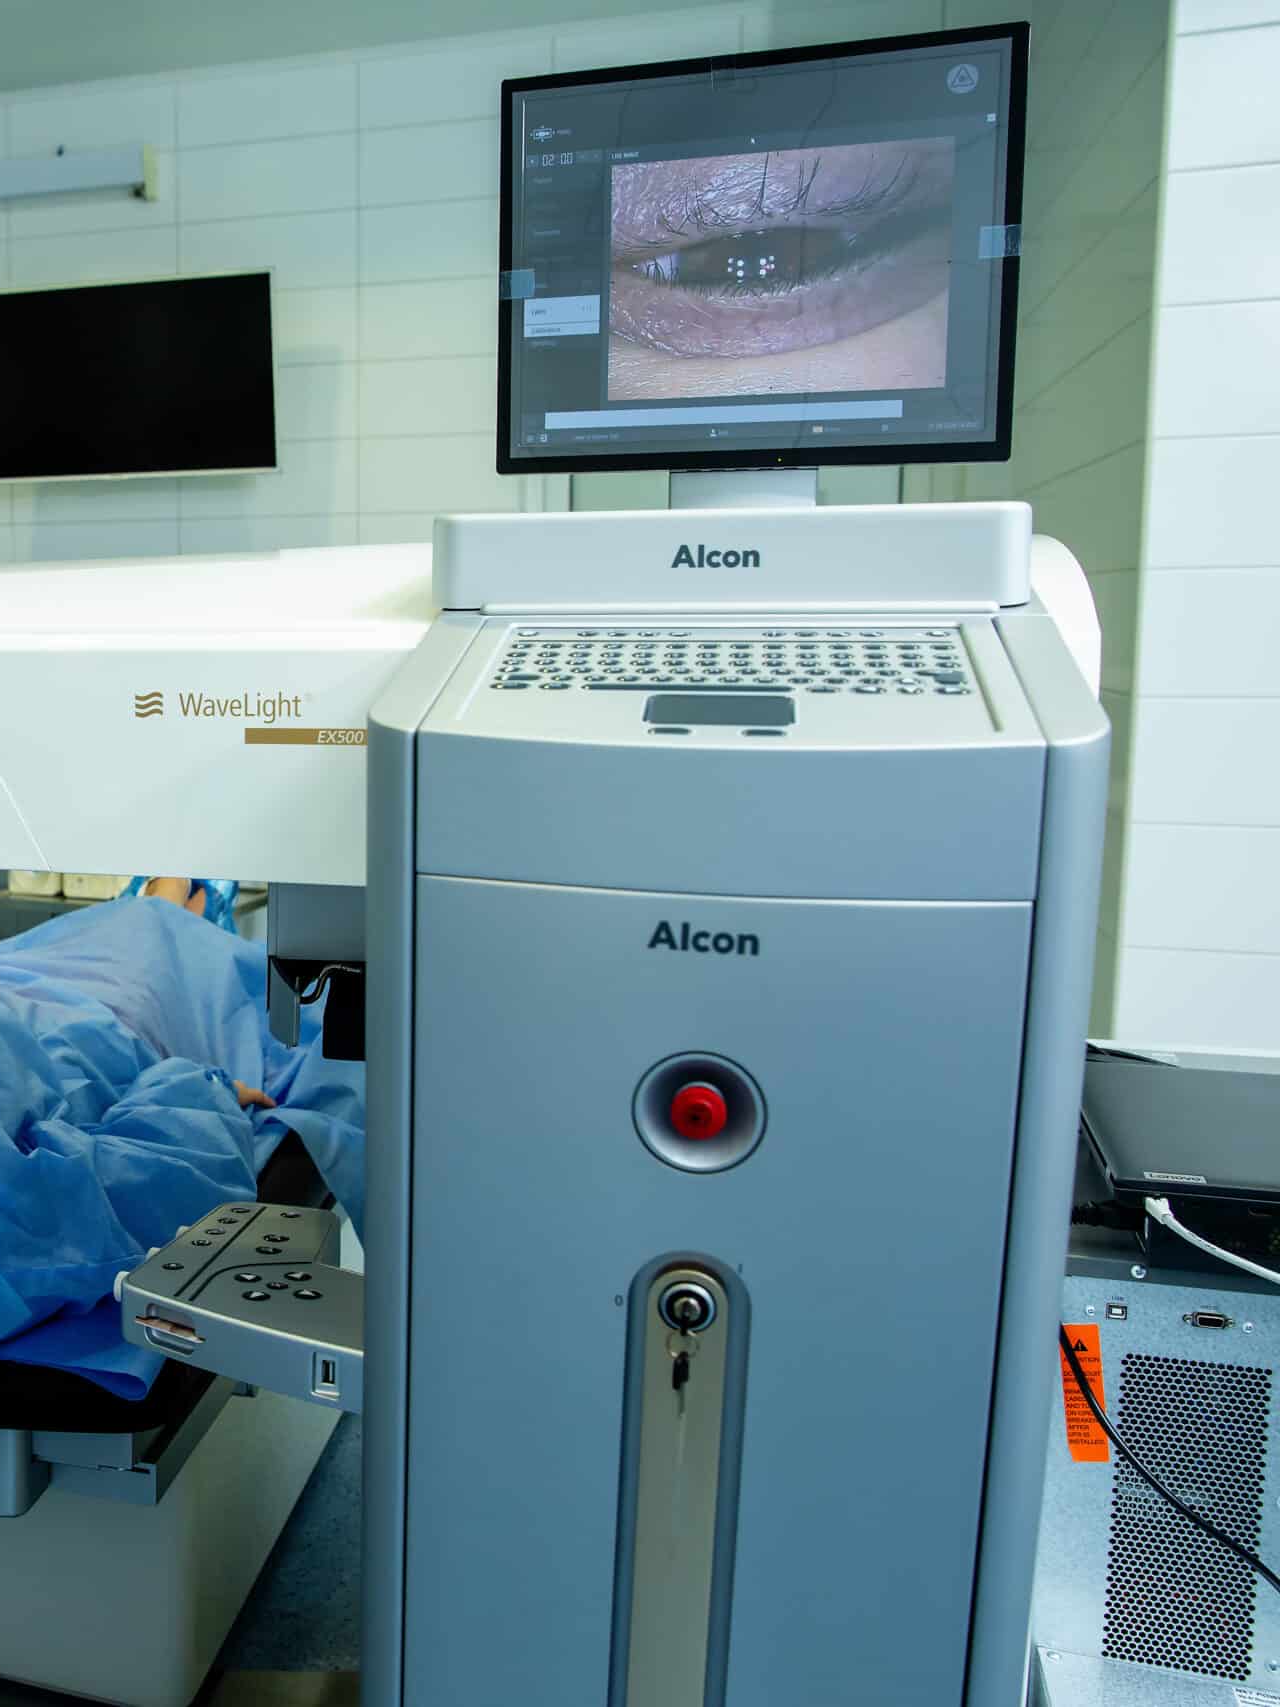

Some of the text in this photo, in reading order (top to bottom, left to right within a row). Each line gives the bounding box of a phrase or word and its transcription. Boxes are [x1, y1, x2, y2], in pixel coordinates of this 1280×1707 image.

[672, 544, 761, 569] Alcon
[179, 691, 302, 724] WaveLight
[317, 730, 365, 745] EX500
[647, 920, 761, 957] Alcon
